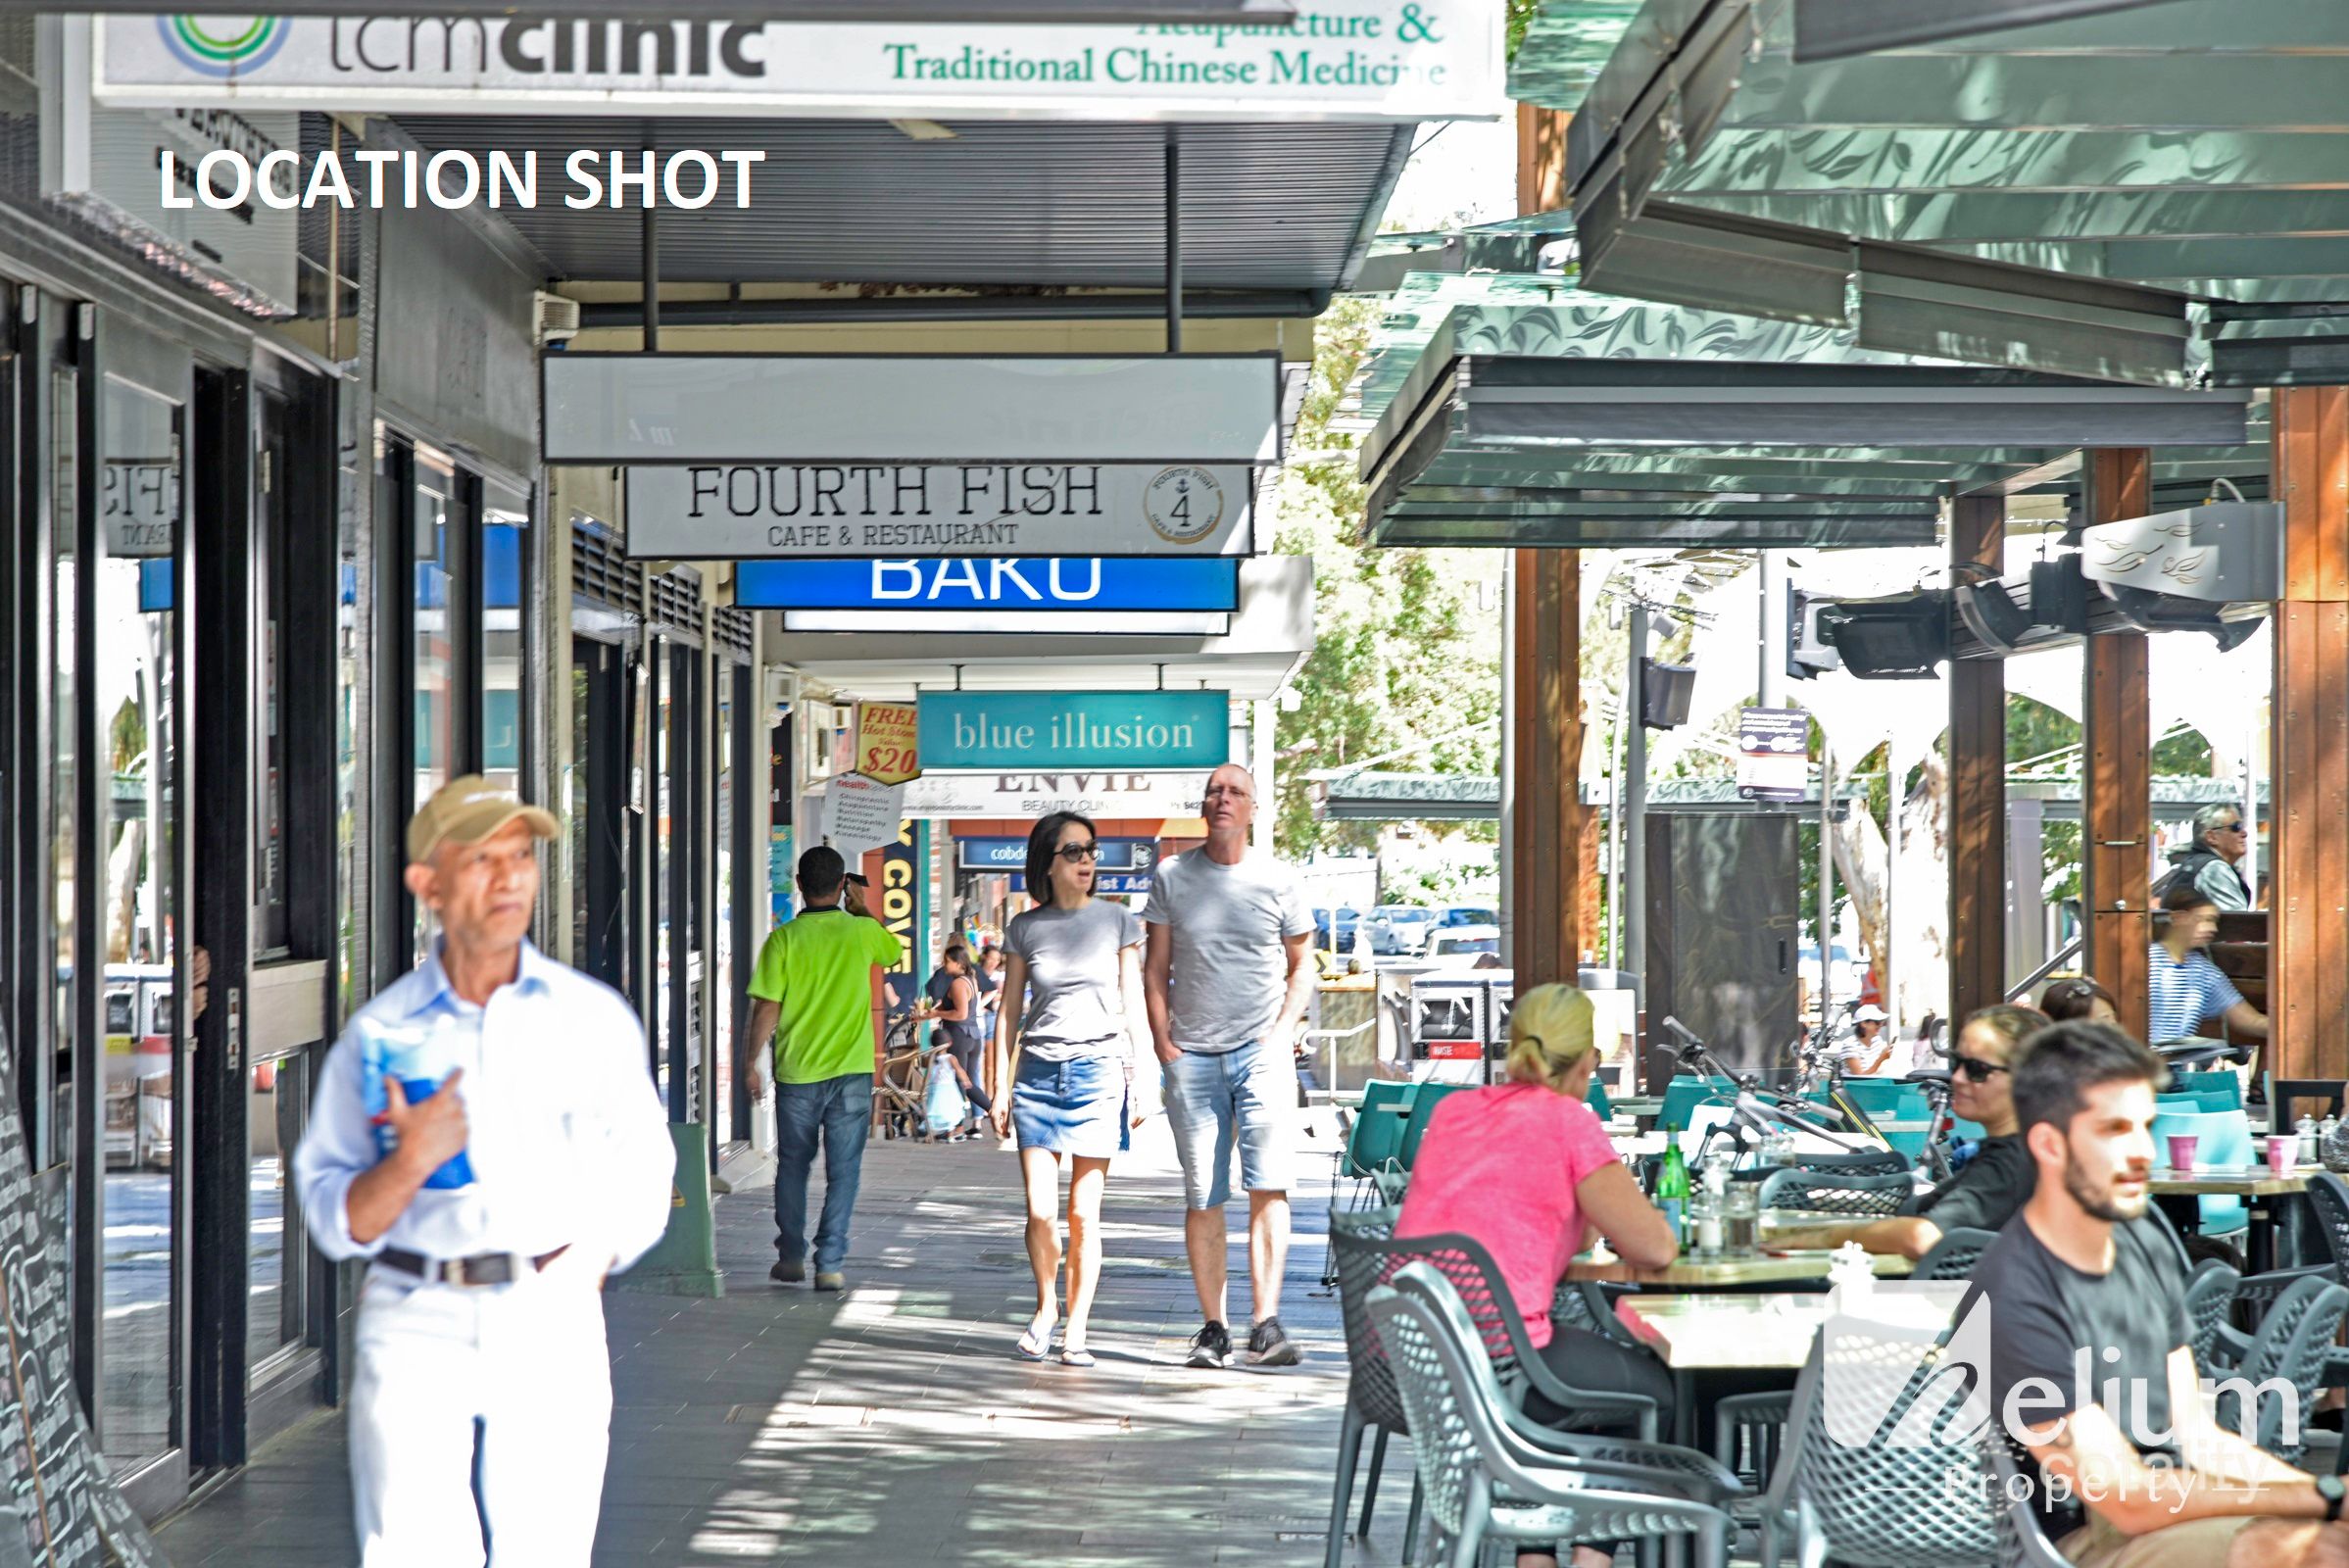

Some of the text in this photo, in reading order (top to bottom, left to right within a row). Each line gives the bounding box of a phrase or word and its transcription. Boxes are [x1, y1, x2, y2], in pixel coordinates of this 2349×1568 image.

[1137, 2, 1445, 48] puncture &
[883, 43, 1446, 86] Traditional Chinese Medicie
[687, 465, 1103, 517] FOURTH FISH
[1168, 493, 1193, 528] 4
[767, 522, 1020, 548] CAFE & RESTAURANT
[870, 558, 1102, 601] BAKU
[862, 707, 917, 726] FREE
[954, 711, 1195, 750] blue illusion
[862, 746, 917, 775] $20
[994, 772, 1152, 793] ENVIE
[1021, 799, 1121, 812] BEAUTY CLIN
[990, 846, 1028, 861] cobd
[883, 858, 913, 974] COVE
